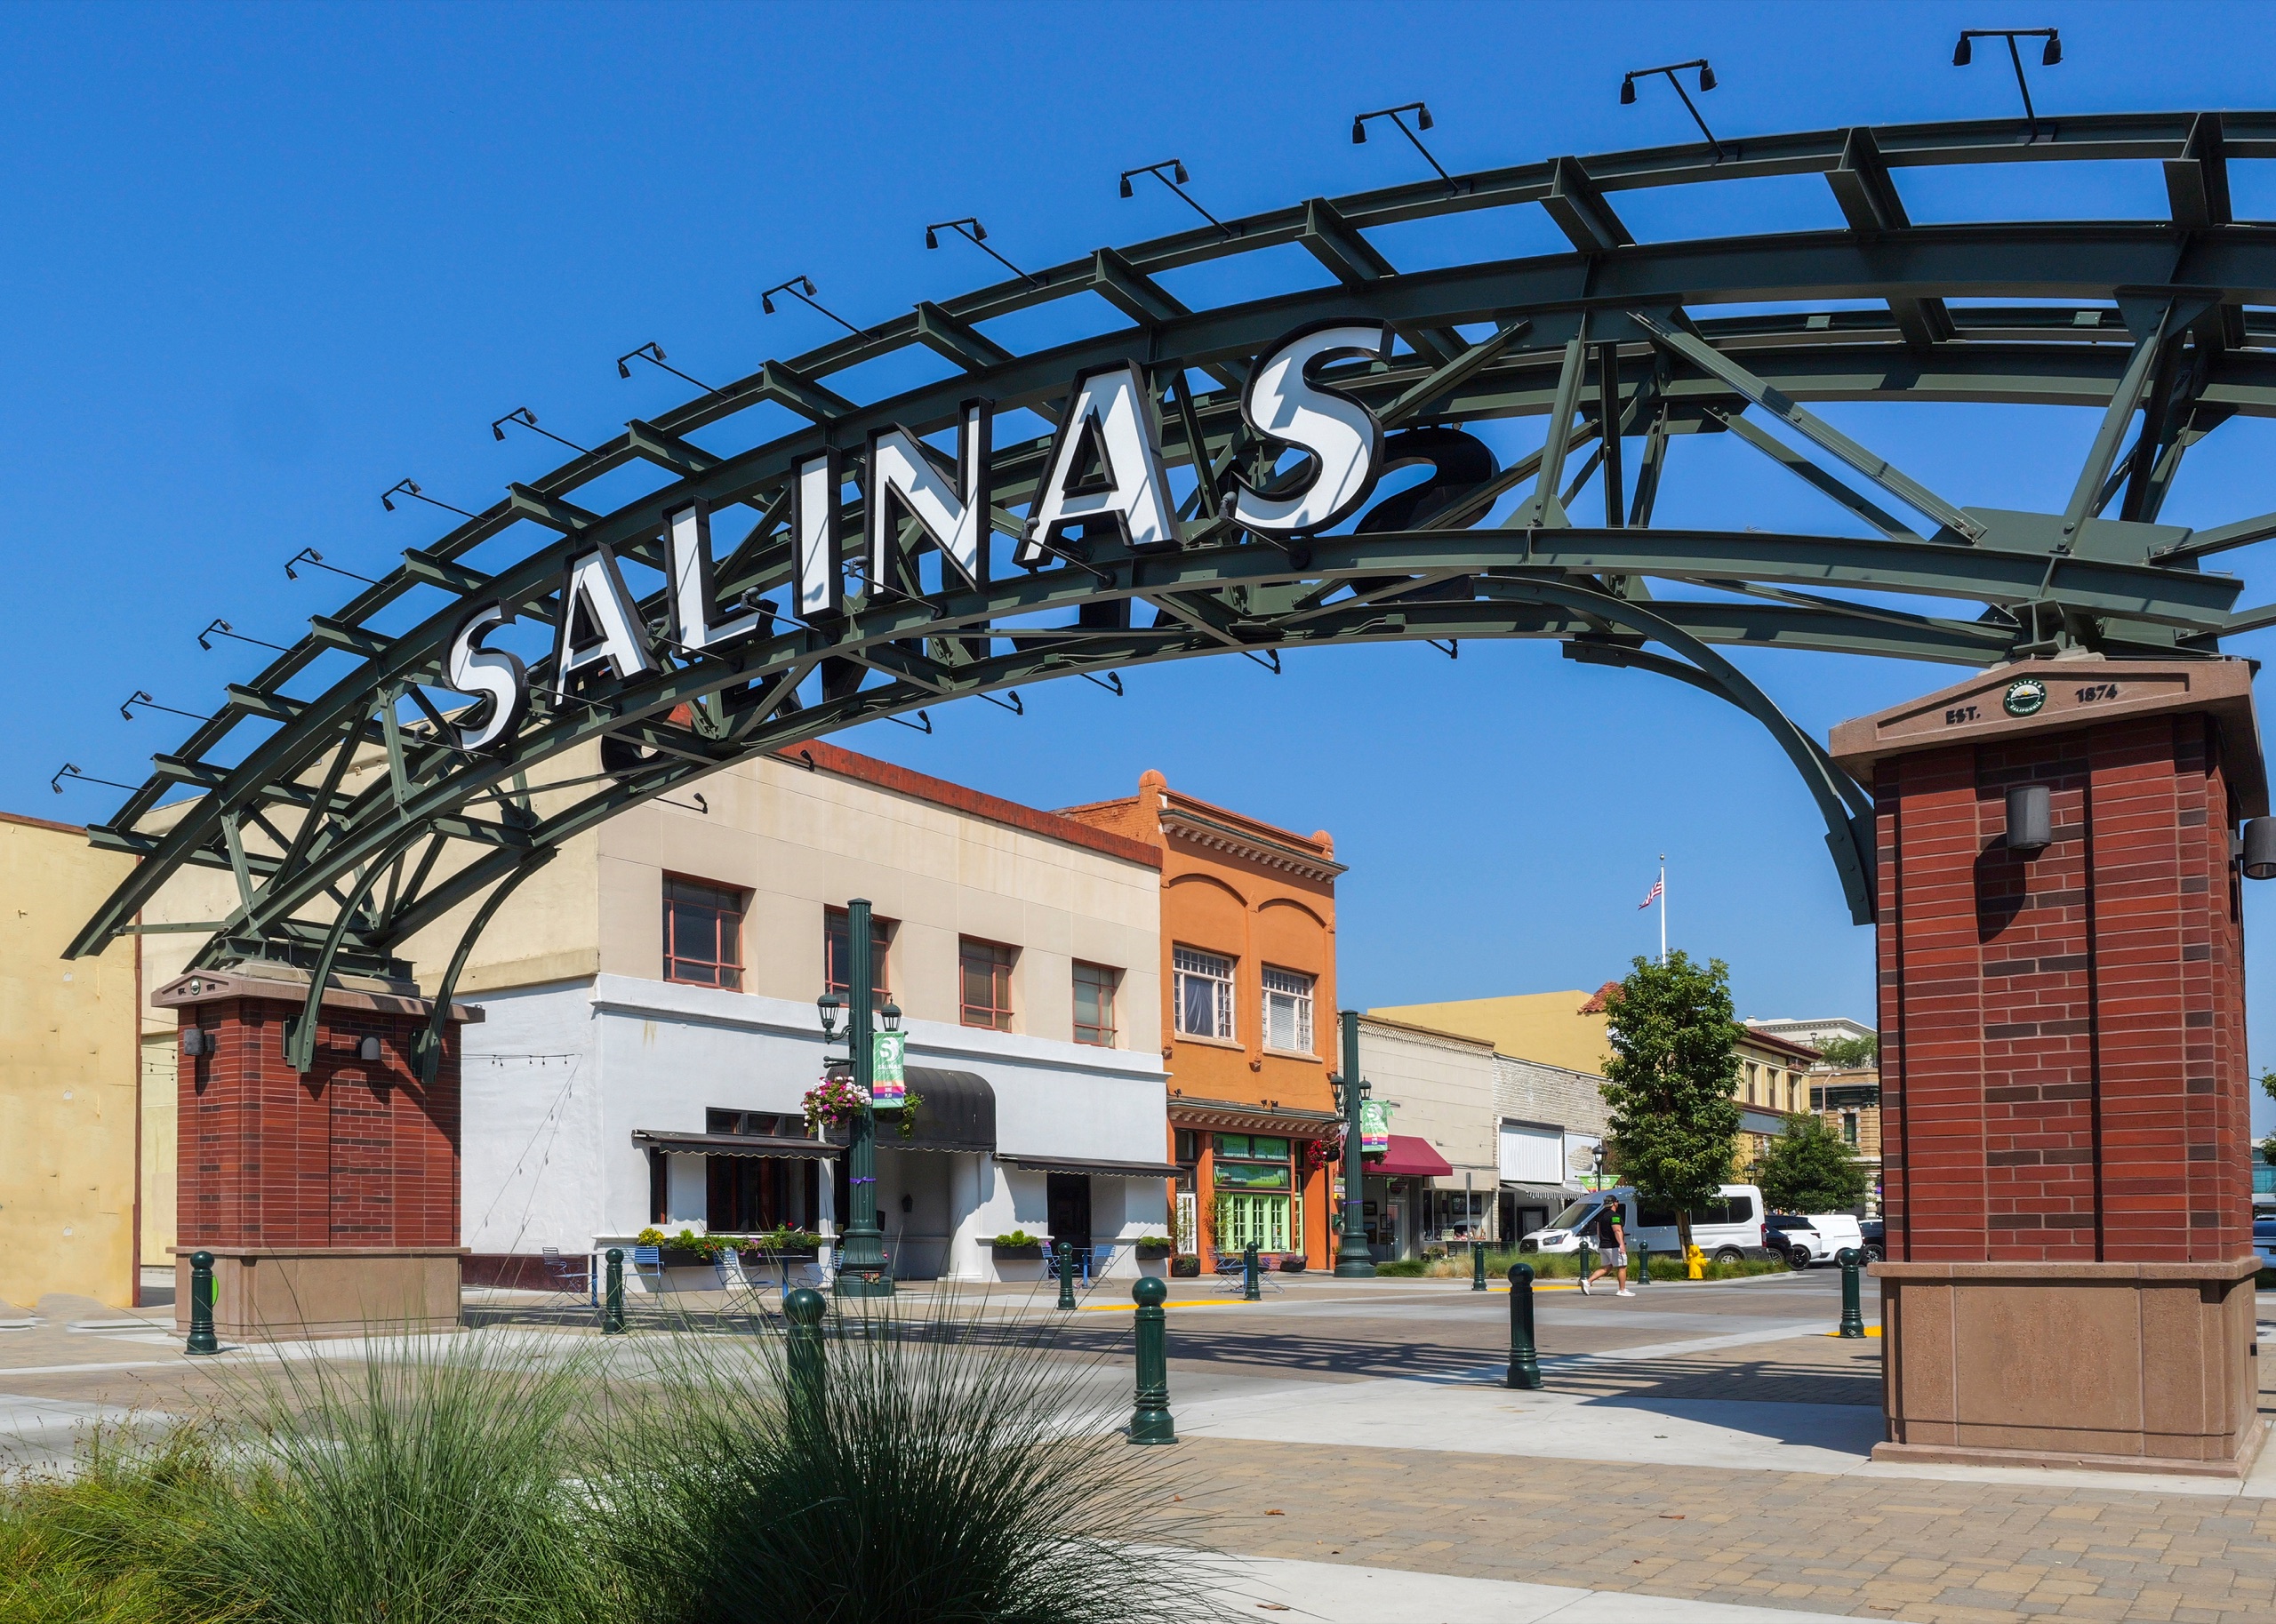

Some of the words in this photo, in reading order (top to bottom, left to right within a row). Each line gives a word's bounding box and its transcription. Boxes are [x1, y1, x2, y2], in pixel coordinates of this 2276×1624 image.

[441, 316, 1395, 755] SALINAS
[2009, 680, 2042, 692] SALINAS
[2075, 684, 2118, 703] 1874
[1946, 706, 1981, 725] EST.
[2009, 701, 2042, 713] CALIFORNIA
